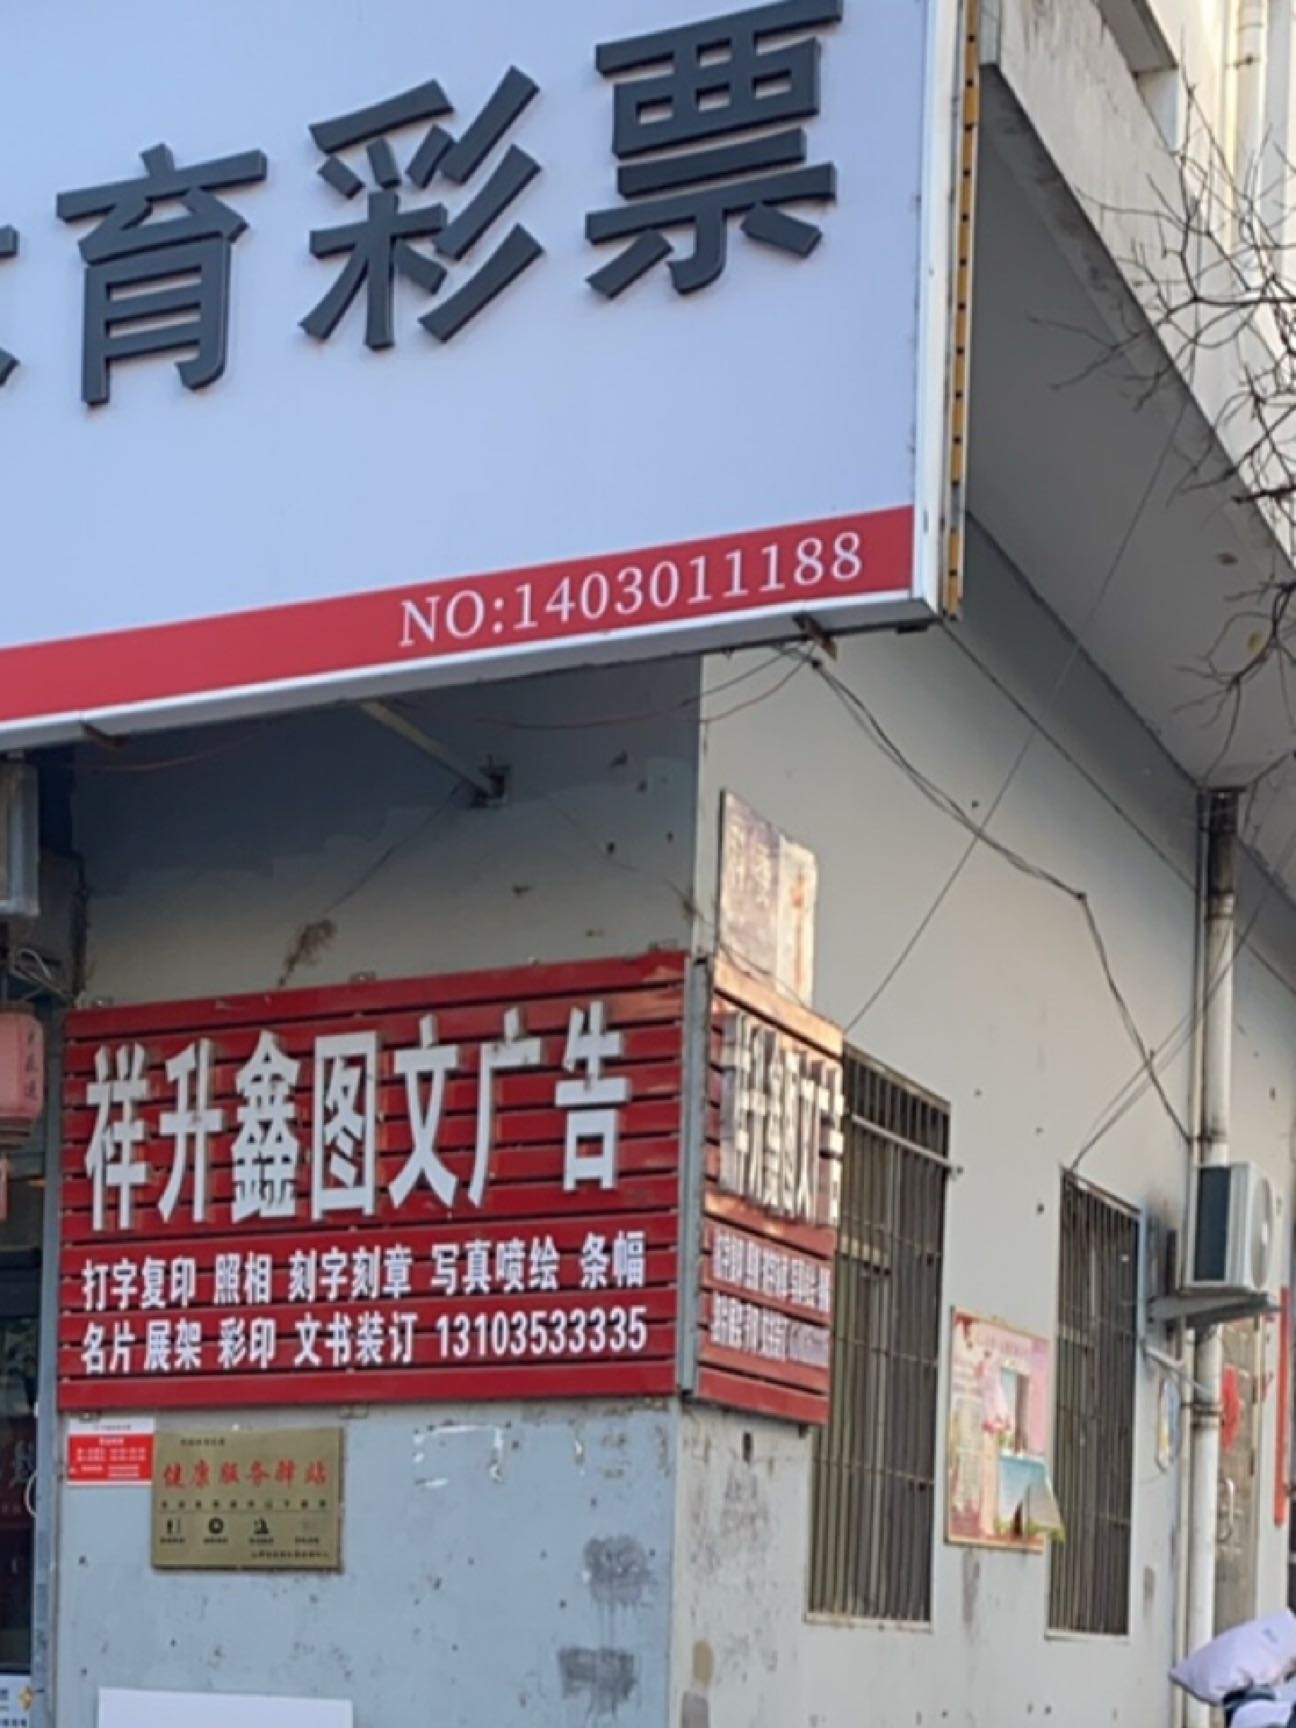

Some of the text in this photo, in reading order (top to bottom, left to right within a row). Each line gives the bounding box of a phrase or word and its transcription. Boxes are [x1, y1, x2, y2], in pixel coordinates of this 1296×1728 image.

[399, 531, 863, 648] NO:1403011188
[85, 1000, 632, 1231] 祥升鑫图文广告
[81, 1254, 196, 1312] 打字复印
[213, 1250, 272, 1304] 照相
[288, 1244, 413, 1303] 刻字刻章
[430, 1235, 561, 1296] 写真喷绘
[580, 1230, 646, 1289] 条幅
[218, 1315, 276, 1370] 彩印
[293, 1310, 418, 1367] 文书装订
[435, 1304, 648, 1359] 13103533335
